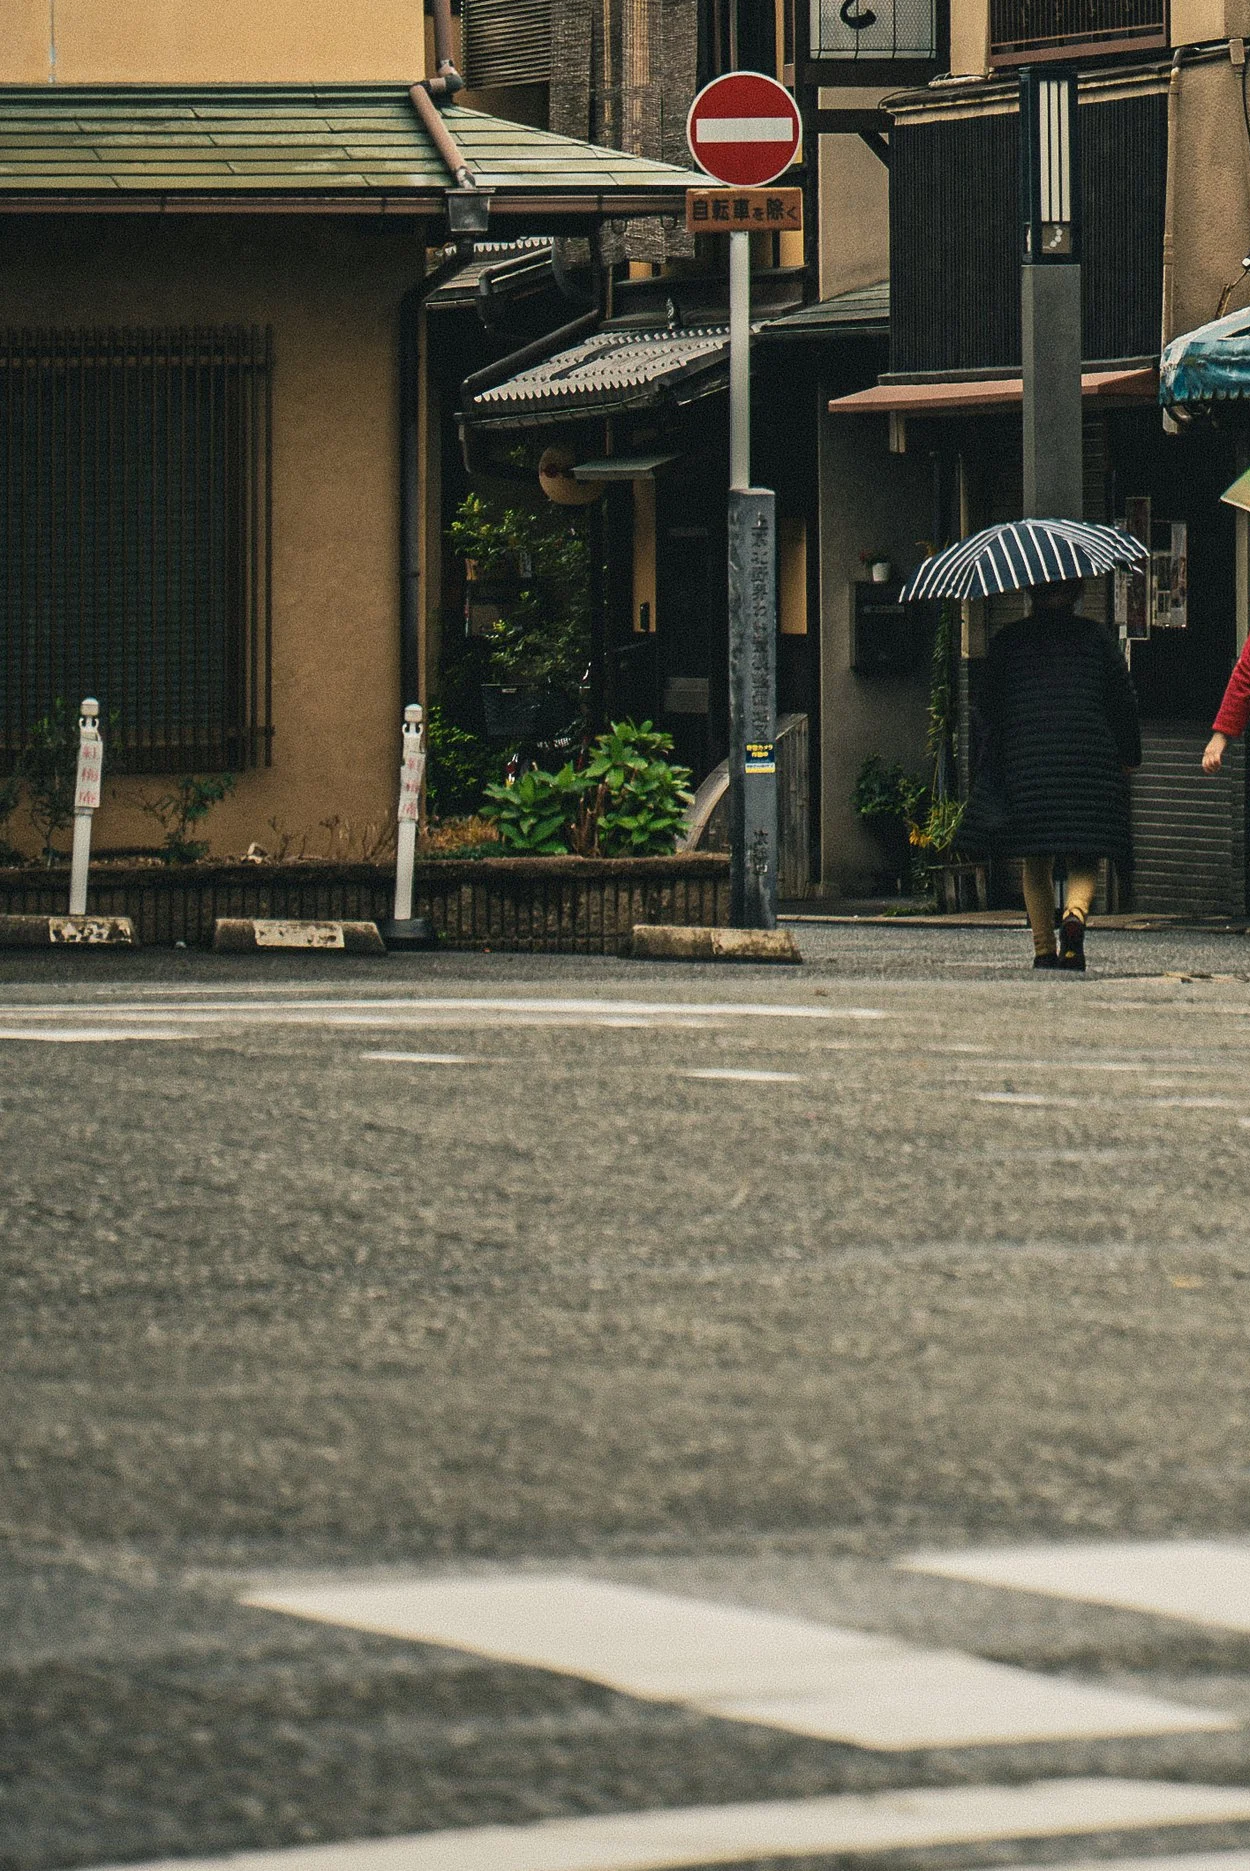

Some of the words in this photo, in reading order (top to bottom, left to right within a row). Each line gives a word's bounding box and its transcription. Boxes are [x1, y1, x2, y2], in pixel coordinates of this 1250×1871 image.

[692, 198, 799, 222] 自転車を除く
